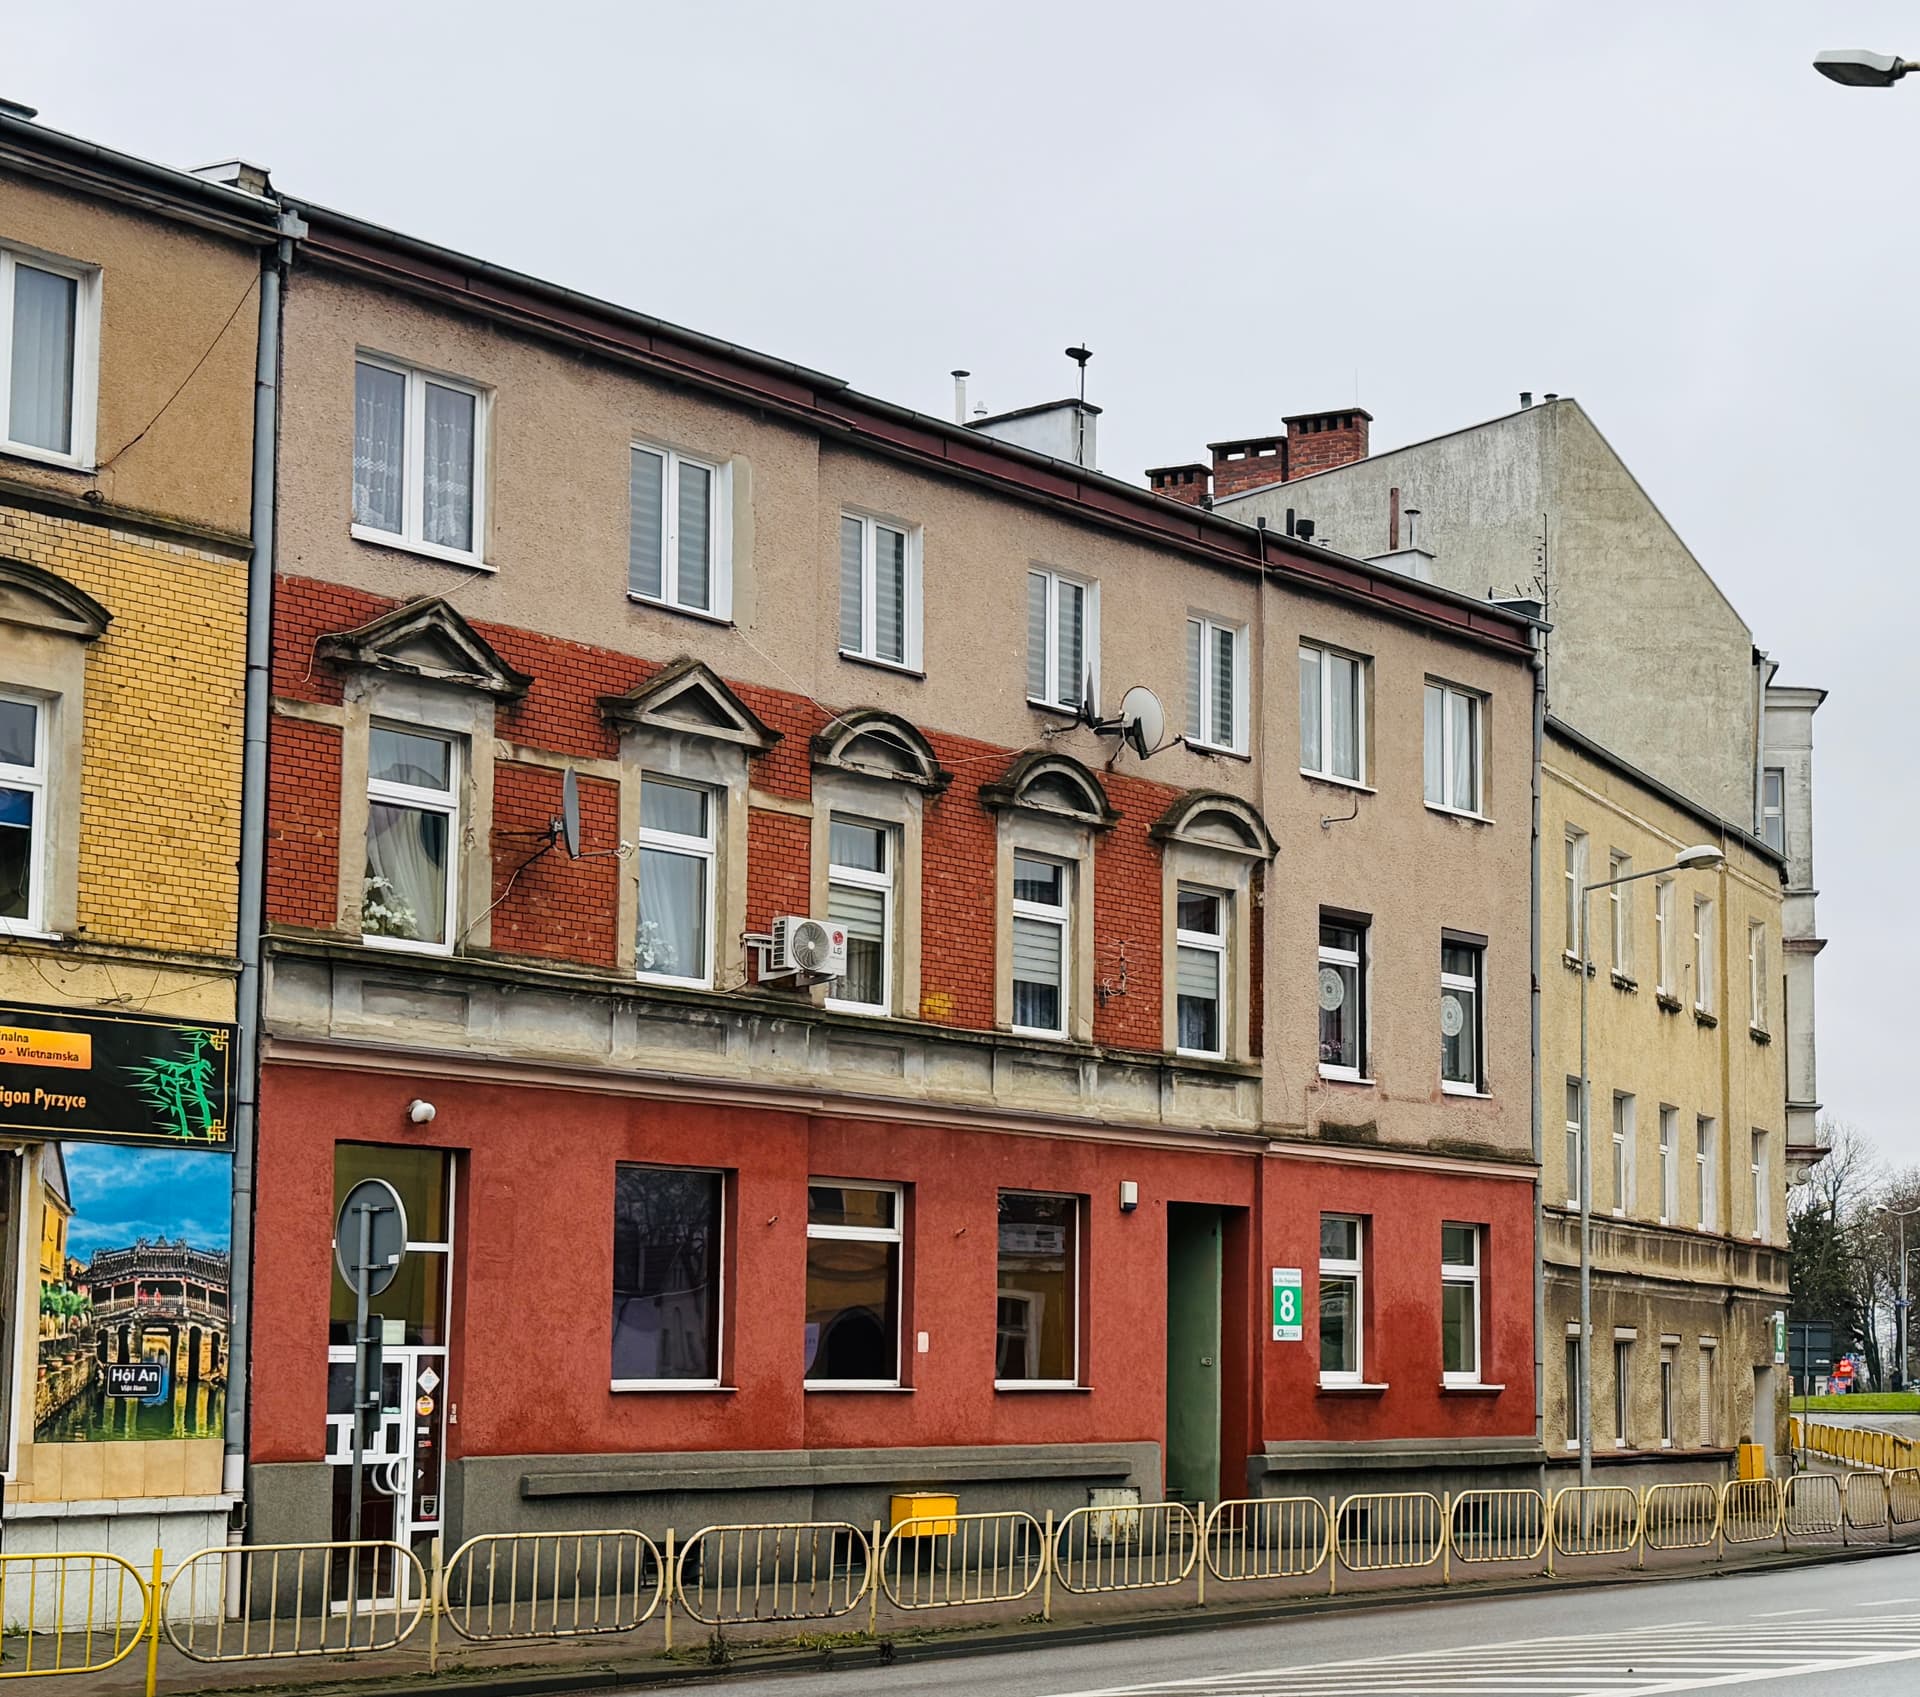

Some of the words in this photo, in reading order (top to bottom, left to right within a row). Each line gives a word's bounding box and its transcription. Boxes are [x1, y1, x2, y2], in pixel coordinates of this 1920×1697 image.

[833, 946, 842, 955] LG
[0, 1031, 29, 1043] nalna
[16, 1047, 80, 1062] Wietnamska
[34, 1087, 87, 1112] Pyrzyce
[1280, 1289, 1296, 1323] 8
[1777, 1327, 1783, 1350] 6
[138, 1368, 158, 1382] An
